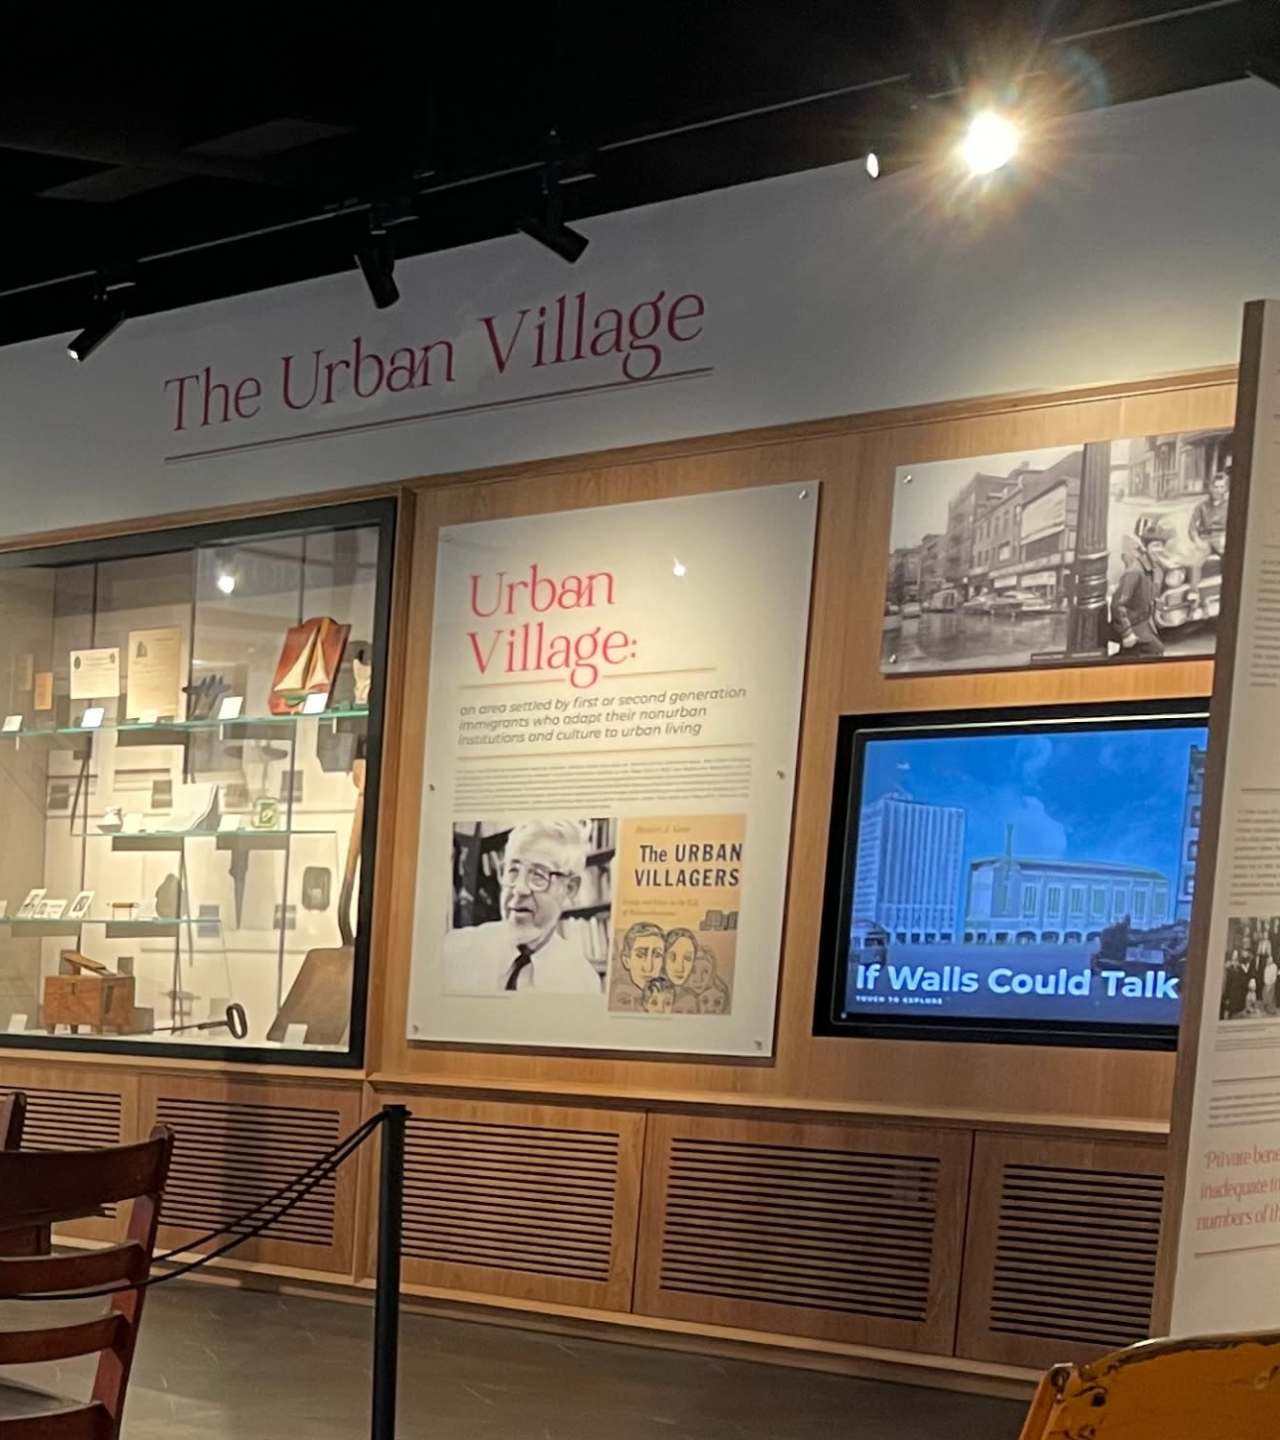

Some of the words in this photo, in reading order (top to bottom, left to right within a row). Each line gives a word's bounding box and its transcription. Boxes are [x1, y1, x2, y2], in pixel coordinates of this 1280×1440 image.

[164, 366, 262, 431] The
[282, 338, 455, 410] Urban
[479, 291, 706, 380] Village
[468, 564, 615, 619] Urban
[466, 622, 639, 689] Village:
[459, 706, 476, 716] an
[478, 703, 507, 714] area
[508, 698, 552, 712] settled
[553, 697, 571, 712] by
[572, 695, 599, 708] first
[600, 696, 615, 706] or
[617, 689, 667, 706] second
[668, 688, 746, 705] generation
[458, 717, 529, 731] immigrants
[532, 713, 560, 727] who
[562, 711, 602, 725] adapt
[604, 708, 636, 722] their
[639, 704, 707, 720] nonurban
[457, 731, 525, 744] institutions
[527, 727, 554, 742] and
[555, 728, 602, 741] culture
[604, 727, 618, 738] to
[620, 724, 661, 737] urban
[664, 721, 702, 736] living
[639, 844, 668, 863] The
[675, 843, 743, 862] URBAN
[634, 869, 740, 887] VILLAGERS
[856, 964, 880, 989] If
[887, 965, 979, 993] Walls
[988, 968, 1091, 996] Could
[1101, 970, 1180, 999] Talk
[856, 995, 885, 1003] TOUCH
[903, 997, 943, 1005] EXPLORE
